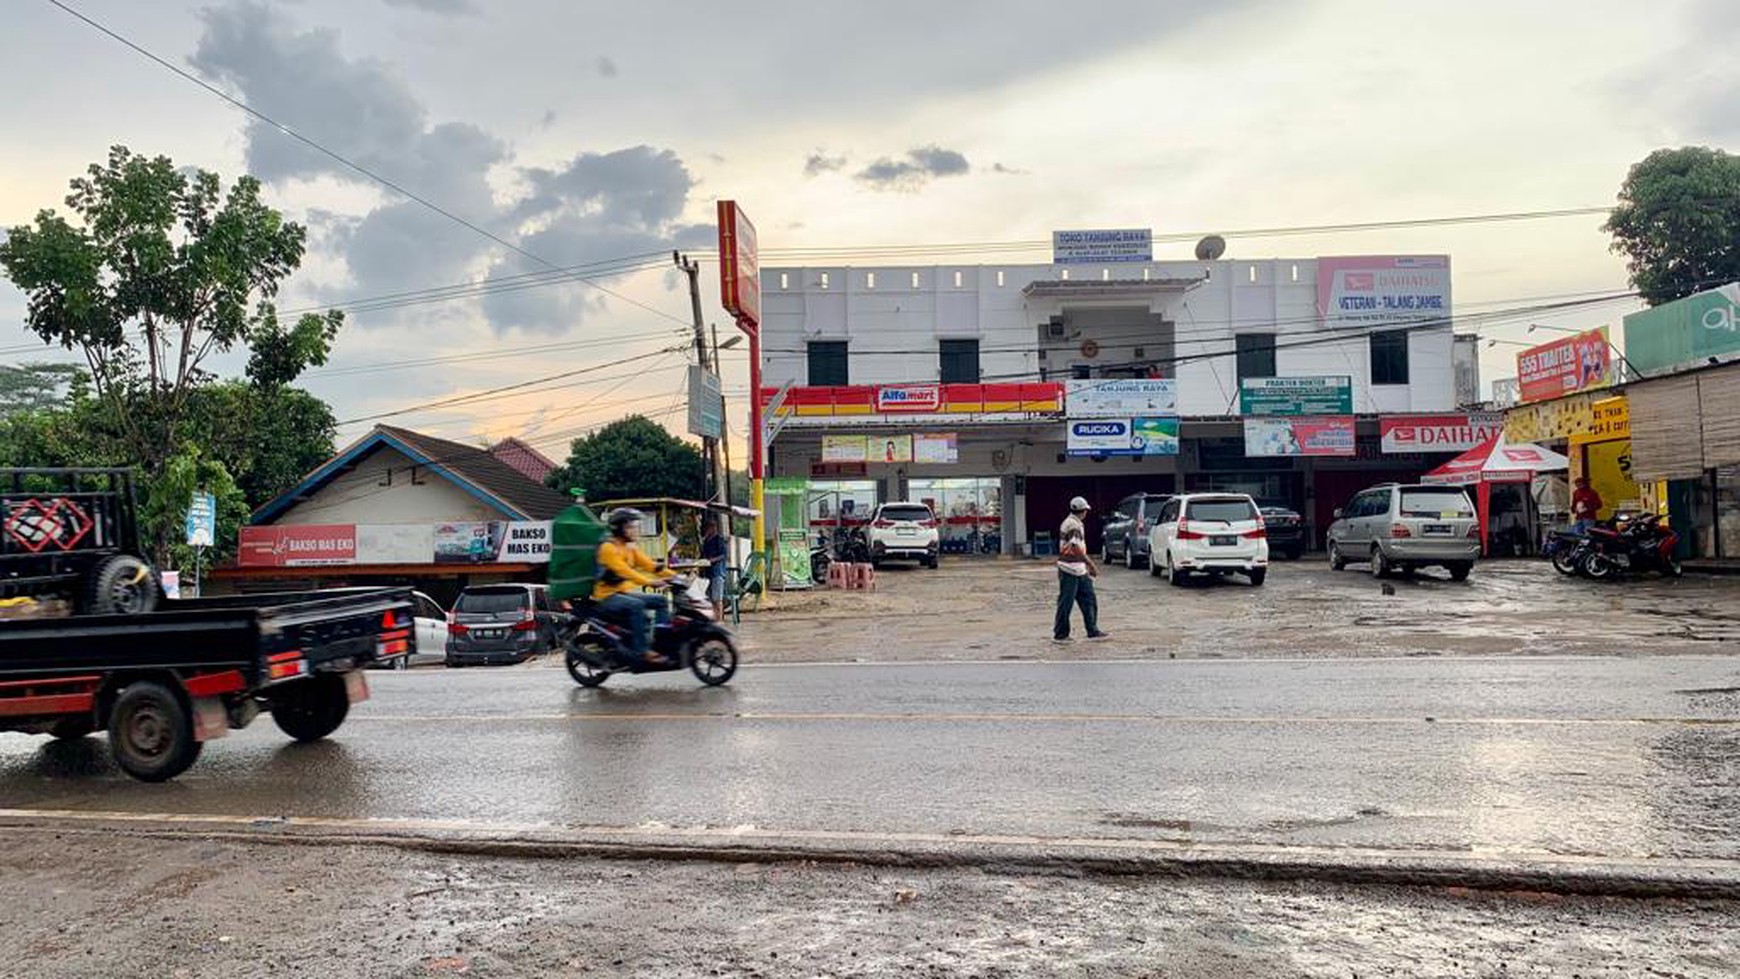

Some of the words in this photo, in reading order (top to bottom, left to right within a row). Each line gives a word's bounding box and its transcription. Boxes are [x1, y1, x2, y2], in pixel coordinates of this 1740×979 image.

[1338, 296, 1376, 310] VETERAN
[1382, 296, 1414, 309] TALANG
[1416, 295, 1442, 309] JAMBE
[1143, 384, 1168, 392] RAYA
[882, 389, 935, 401] Alfamart
[1078, 425, 1120, 434] RUCIKA
[512, 528, 546, 540] BAKSO
[289, 539, 316, 552] BAKSO
[318, 539, 336, 551] MAS
[337, 538, 354, 550] EKO
[507, 543, 531, 555] MAS
[532, 543, 551, 554] EKO
